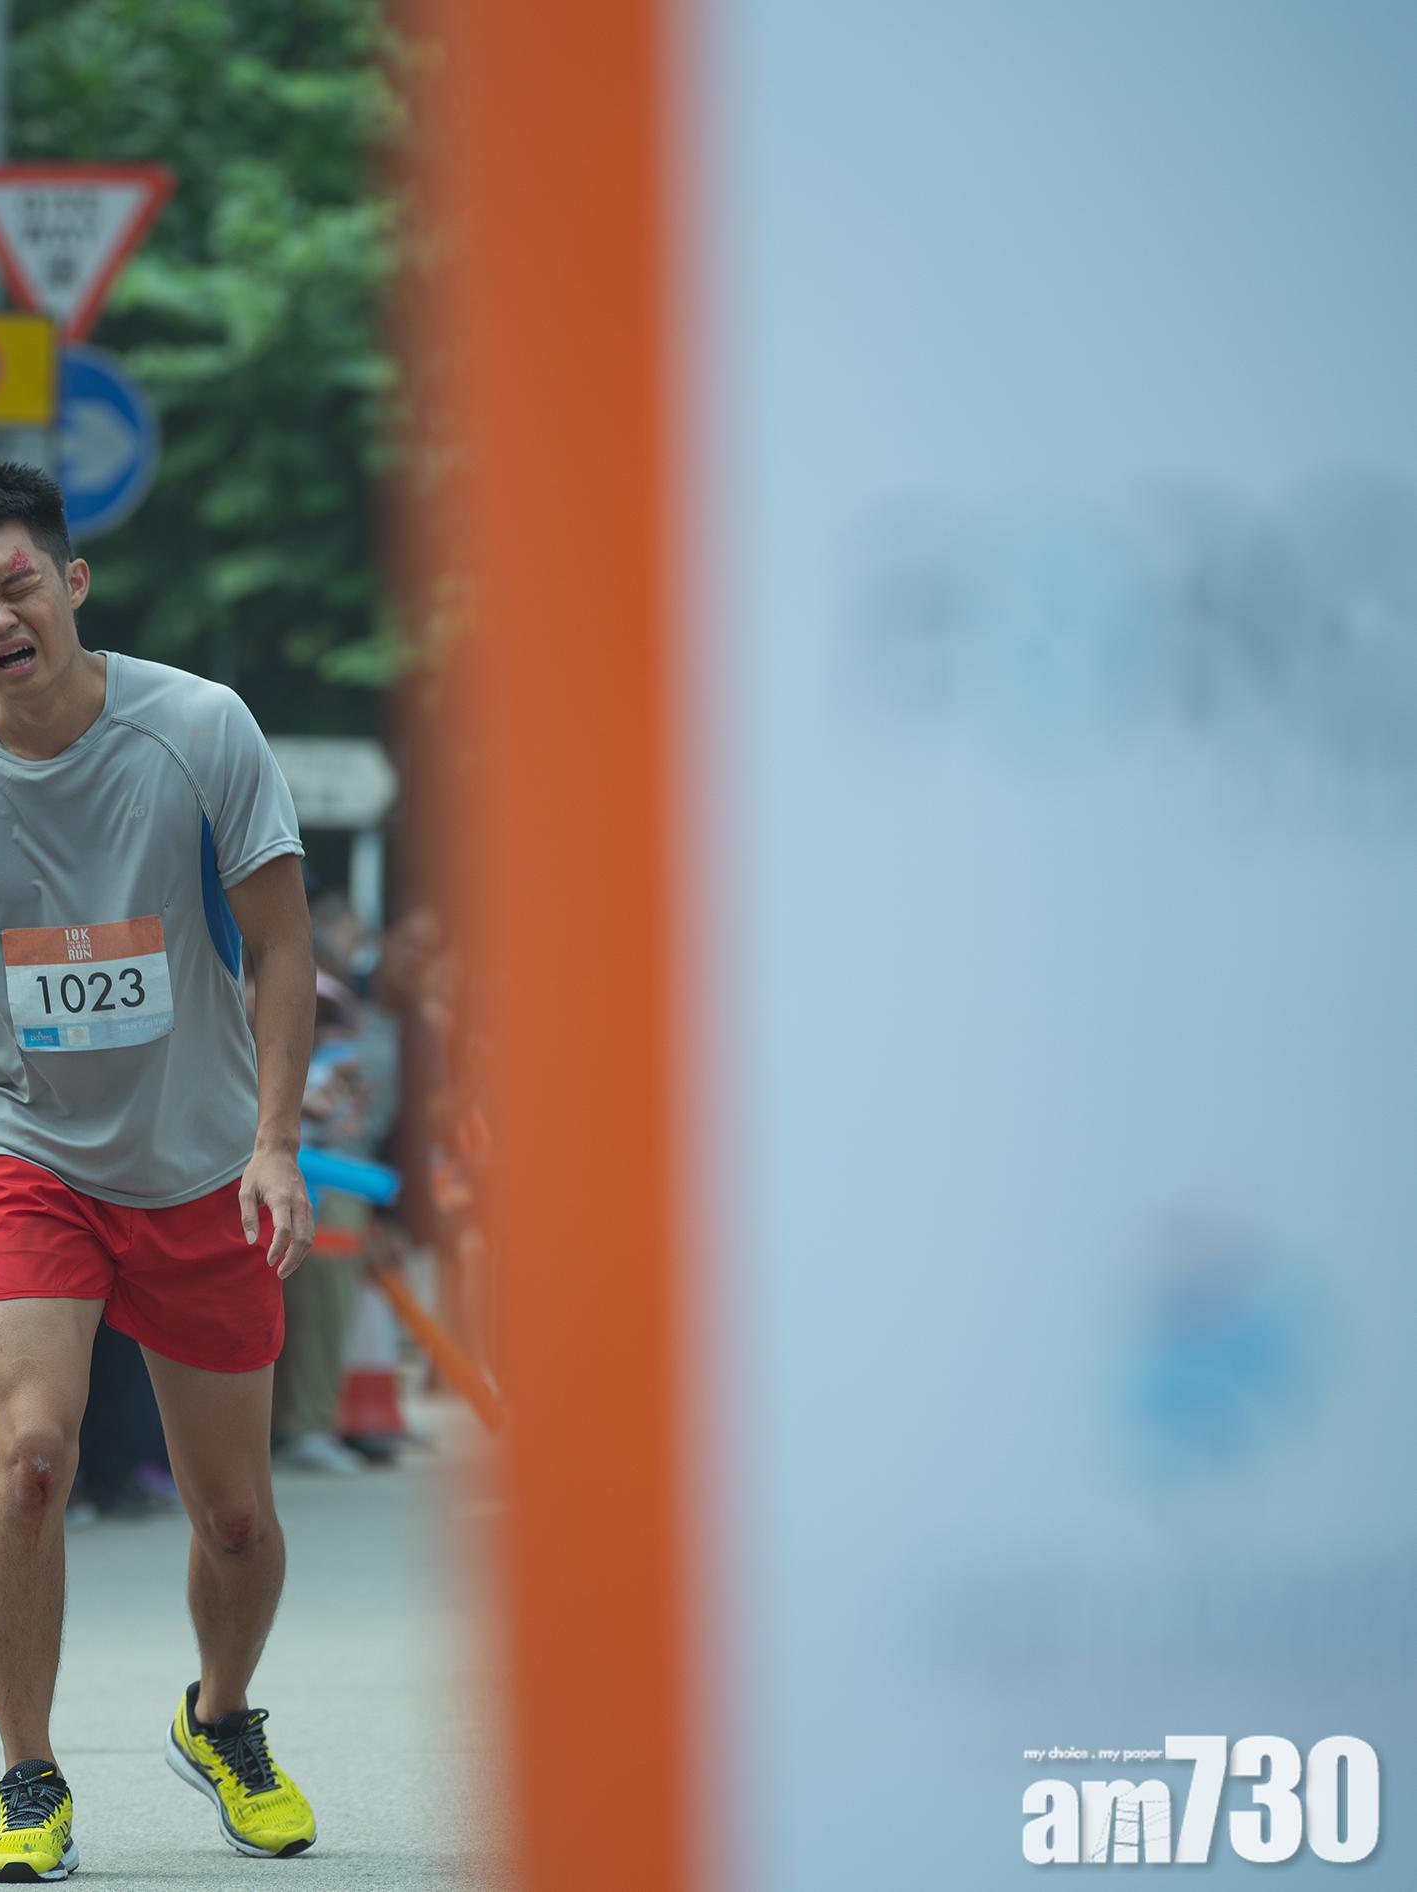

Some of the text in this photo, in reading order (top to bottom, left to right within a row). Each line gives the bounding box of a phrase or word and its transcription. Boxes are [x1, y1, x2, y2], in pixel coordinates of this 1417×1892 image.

[64, 927, 90, 941] 10K
[68, 948, 93, 961] RUN
[36, 967, 145, 1014] 1023
